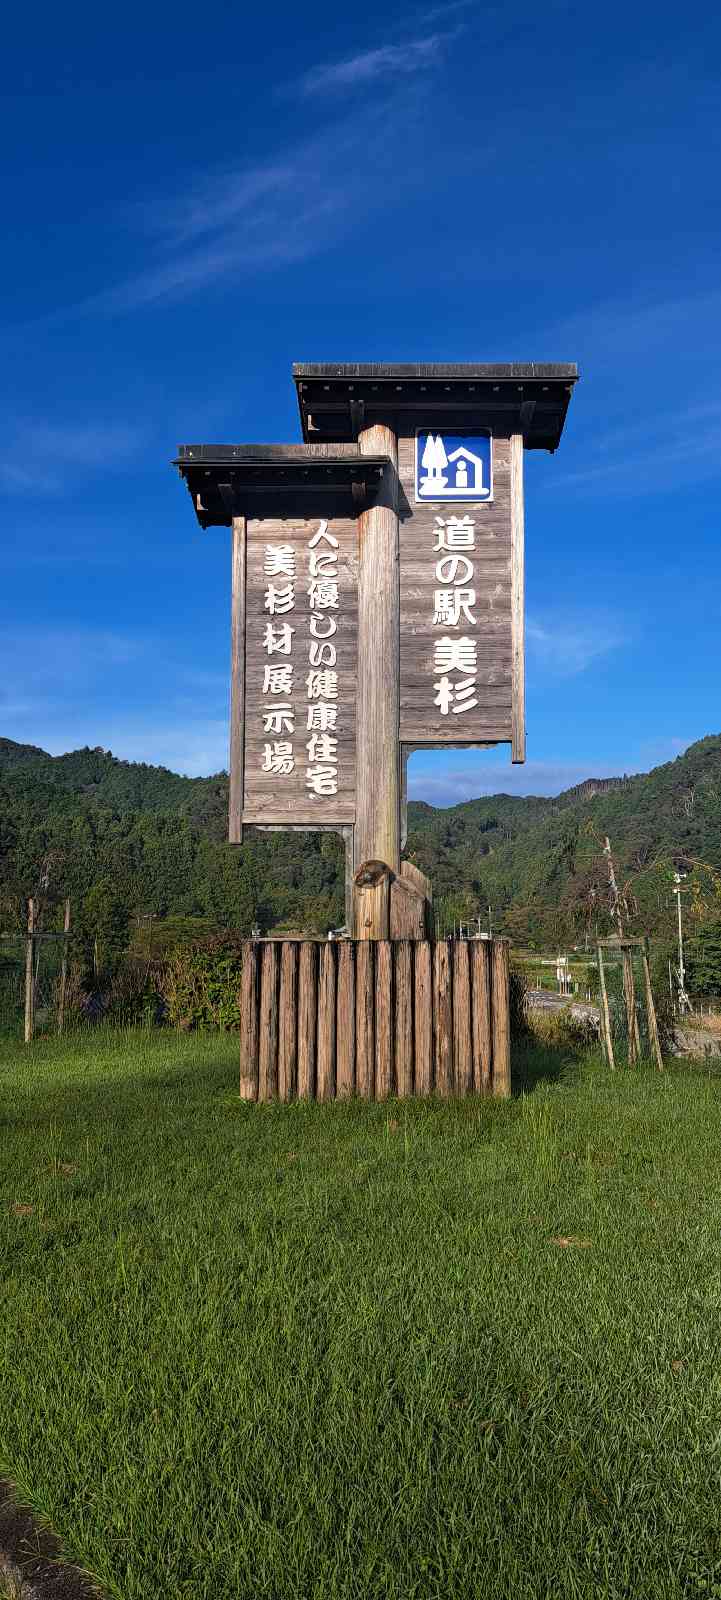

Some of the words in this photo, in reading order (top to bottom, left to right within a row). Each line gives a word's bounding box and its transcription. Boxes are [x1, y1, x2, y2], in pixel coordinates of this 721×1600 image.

[262, 545, 296, 774] 美杉材展示場
[306, 519, 339, 796] 人に優しい健康住宅
